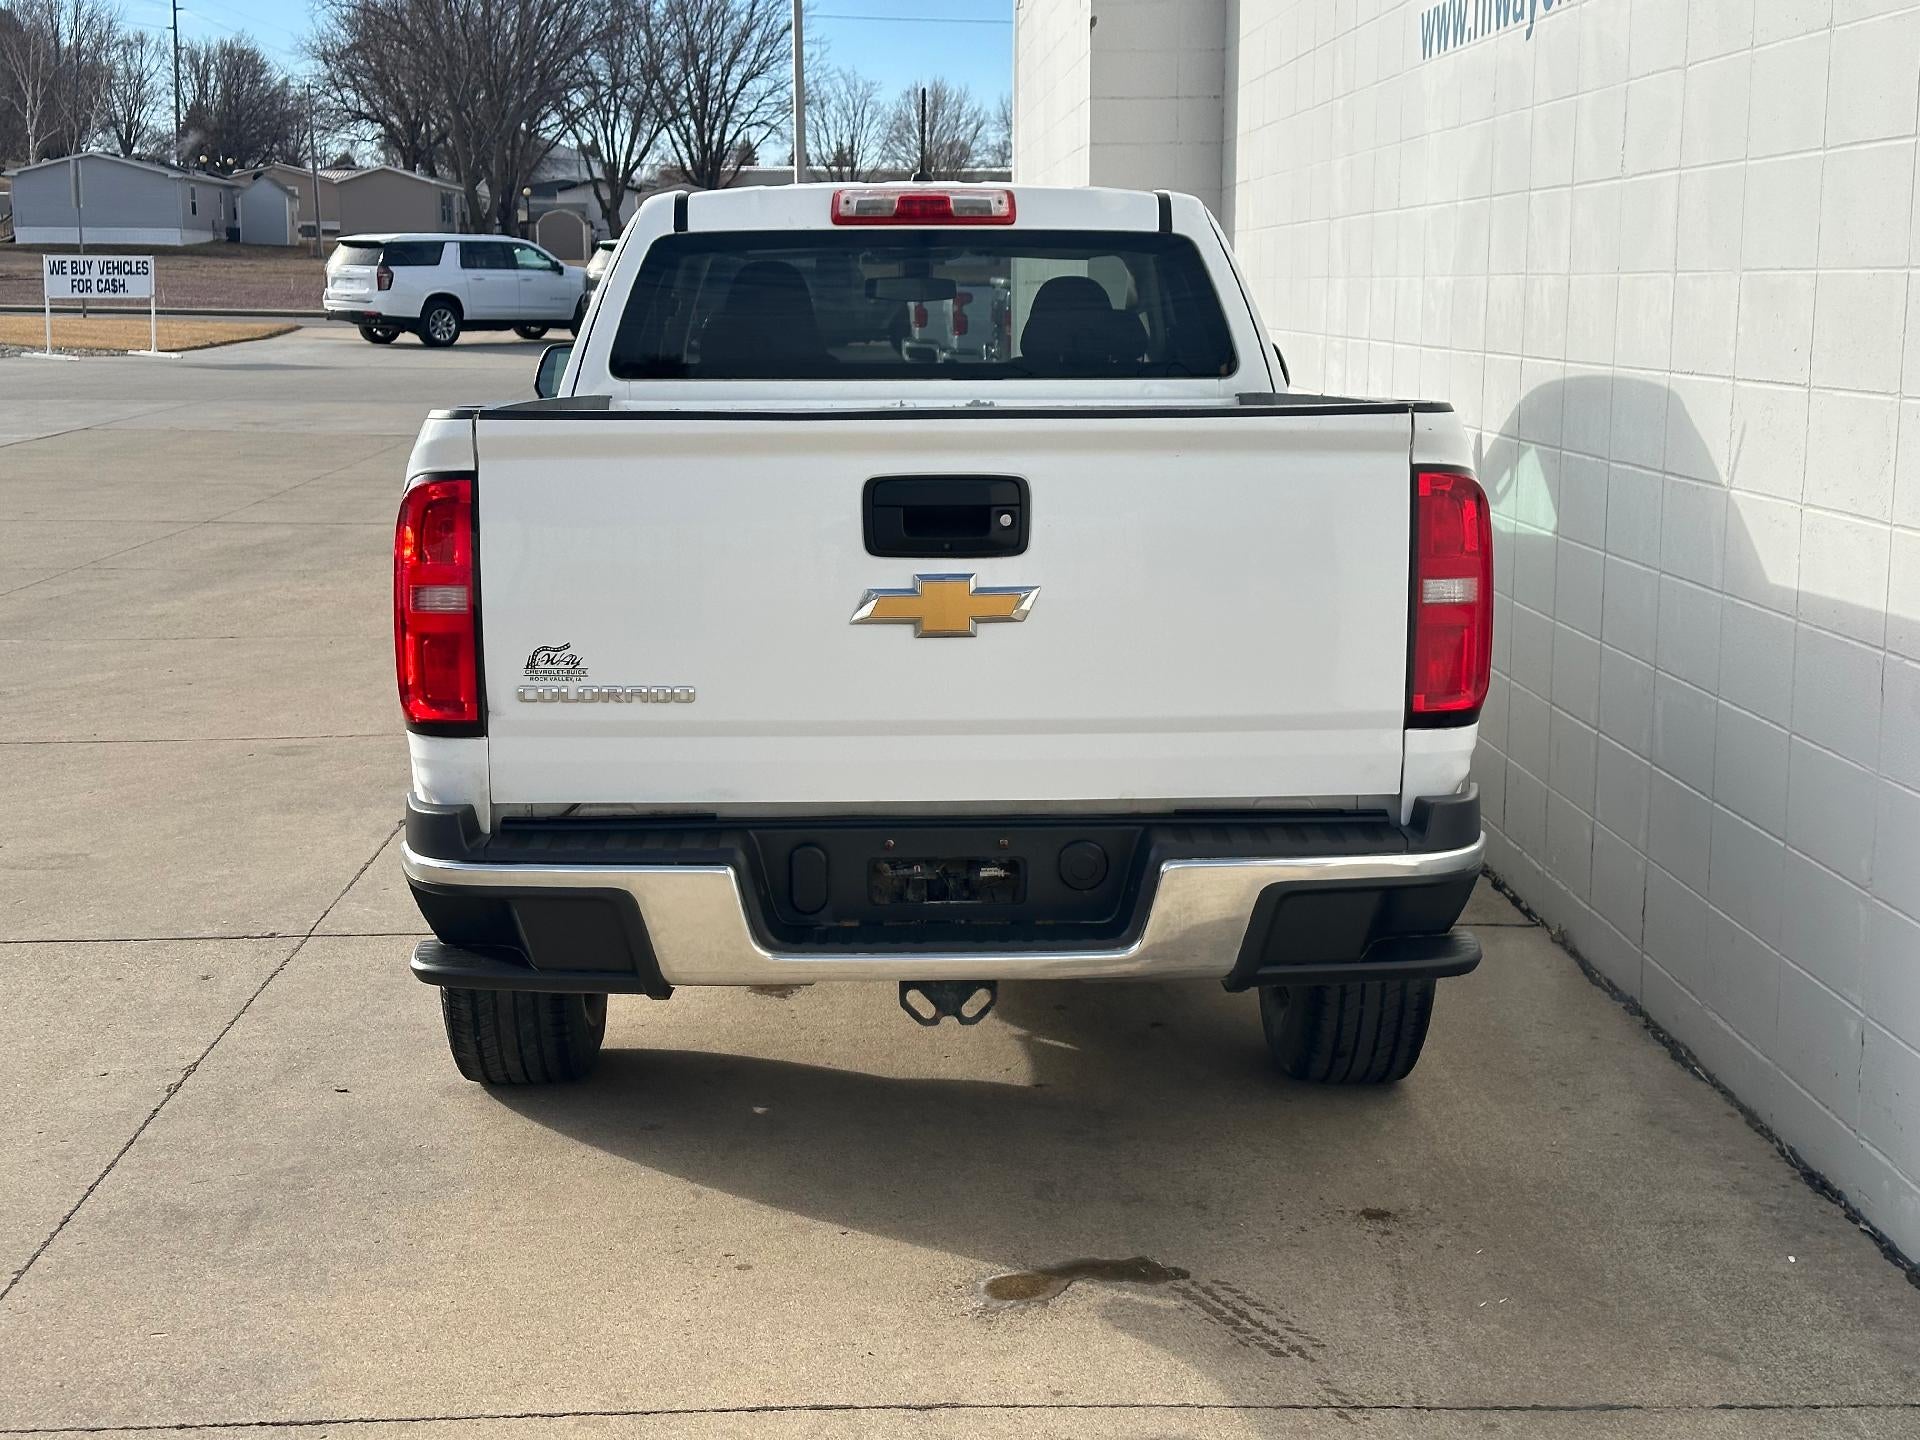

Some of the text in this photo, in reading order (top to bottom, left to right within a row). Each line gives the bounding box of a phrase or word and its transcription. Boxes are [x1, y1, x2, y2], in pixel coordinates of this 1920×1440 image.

[48, 260, 149, 276] WE BUY VEHICLES
[71, 278, 129, 294] FOR CA$H.
[517, 685, 696, 704] COLORADO
